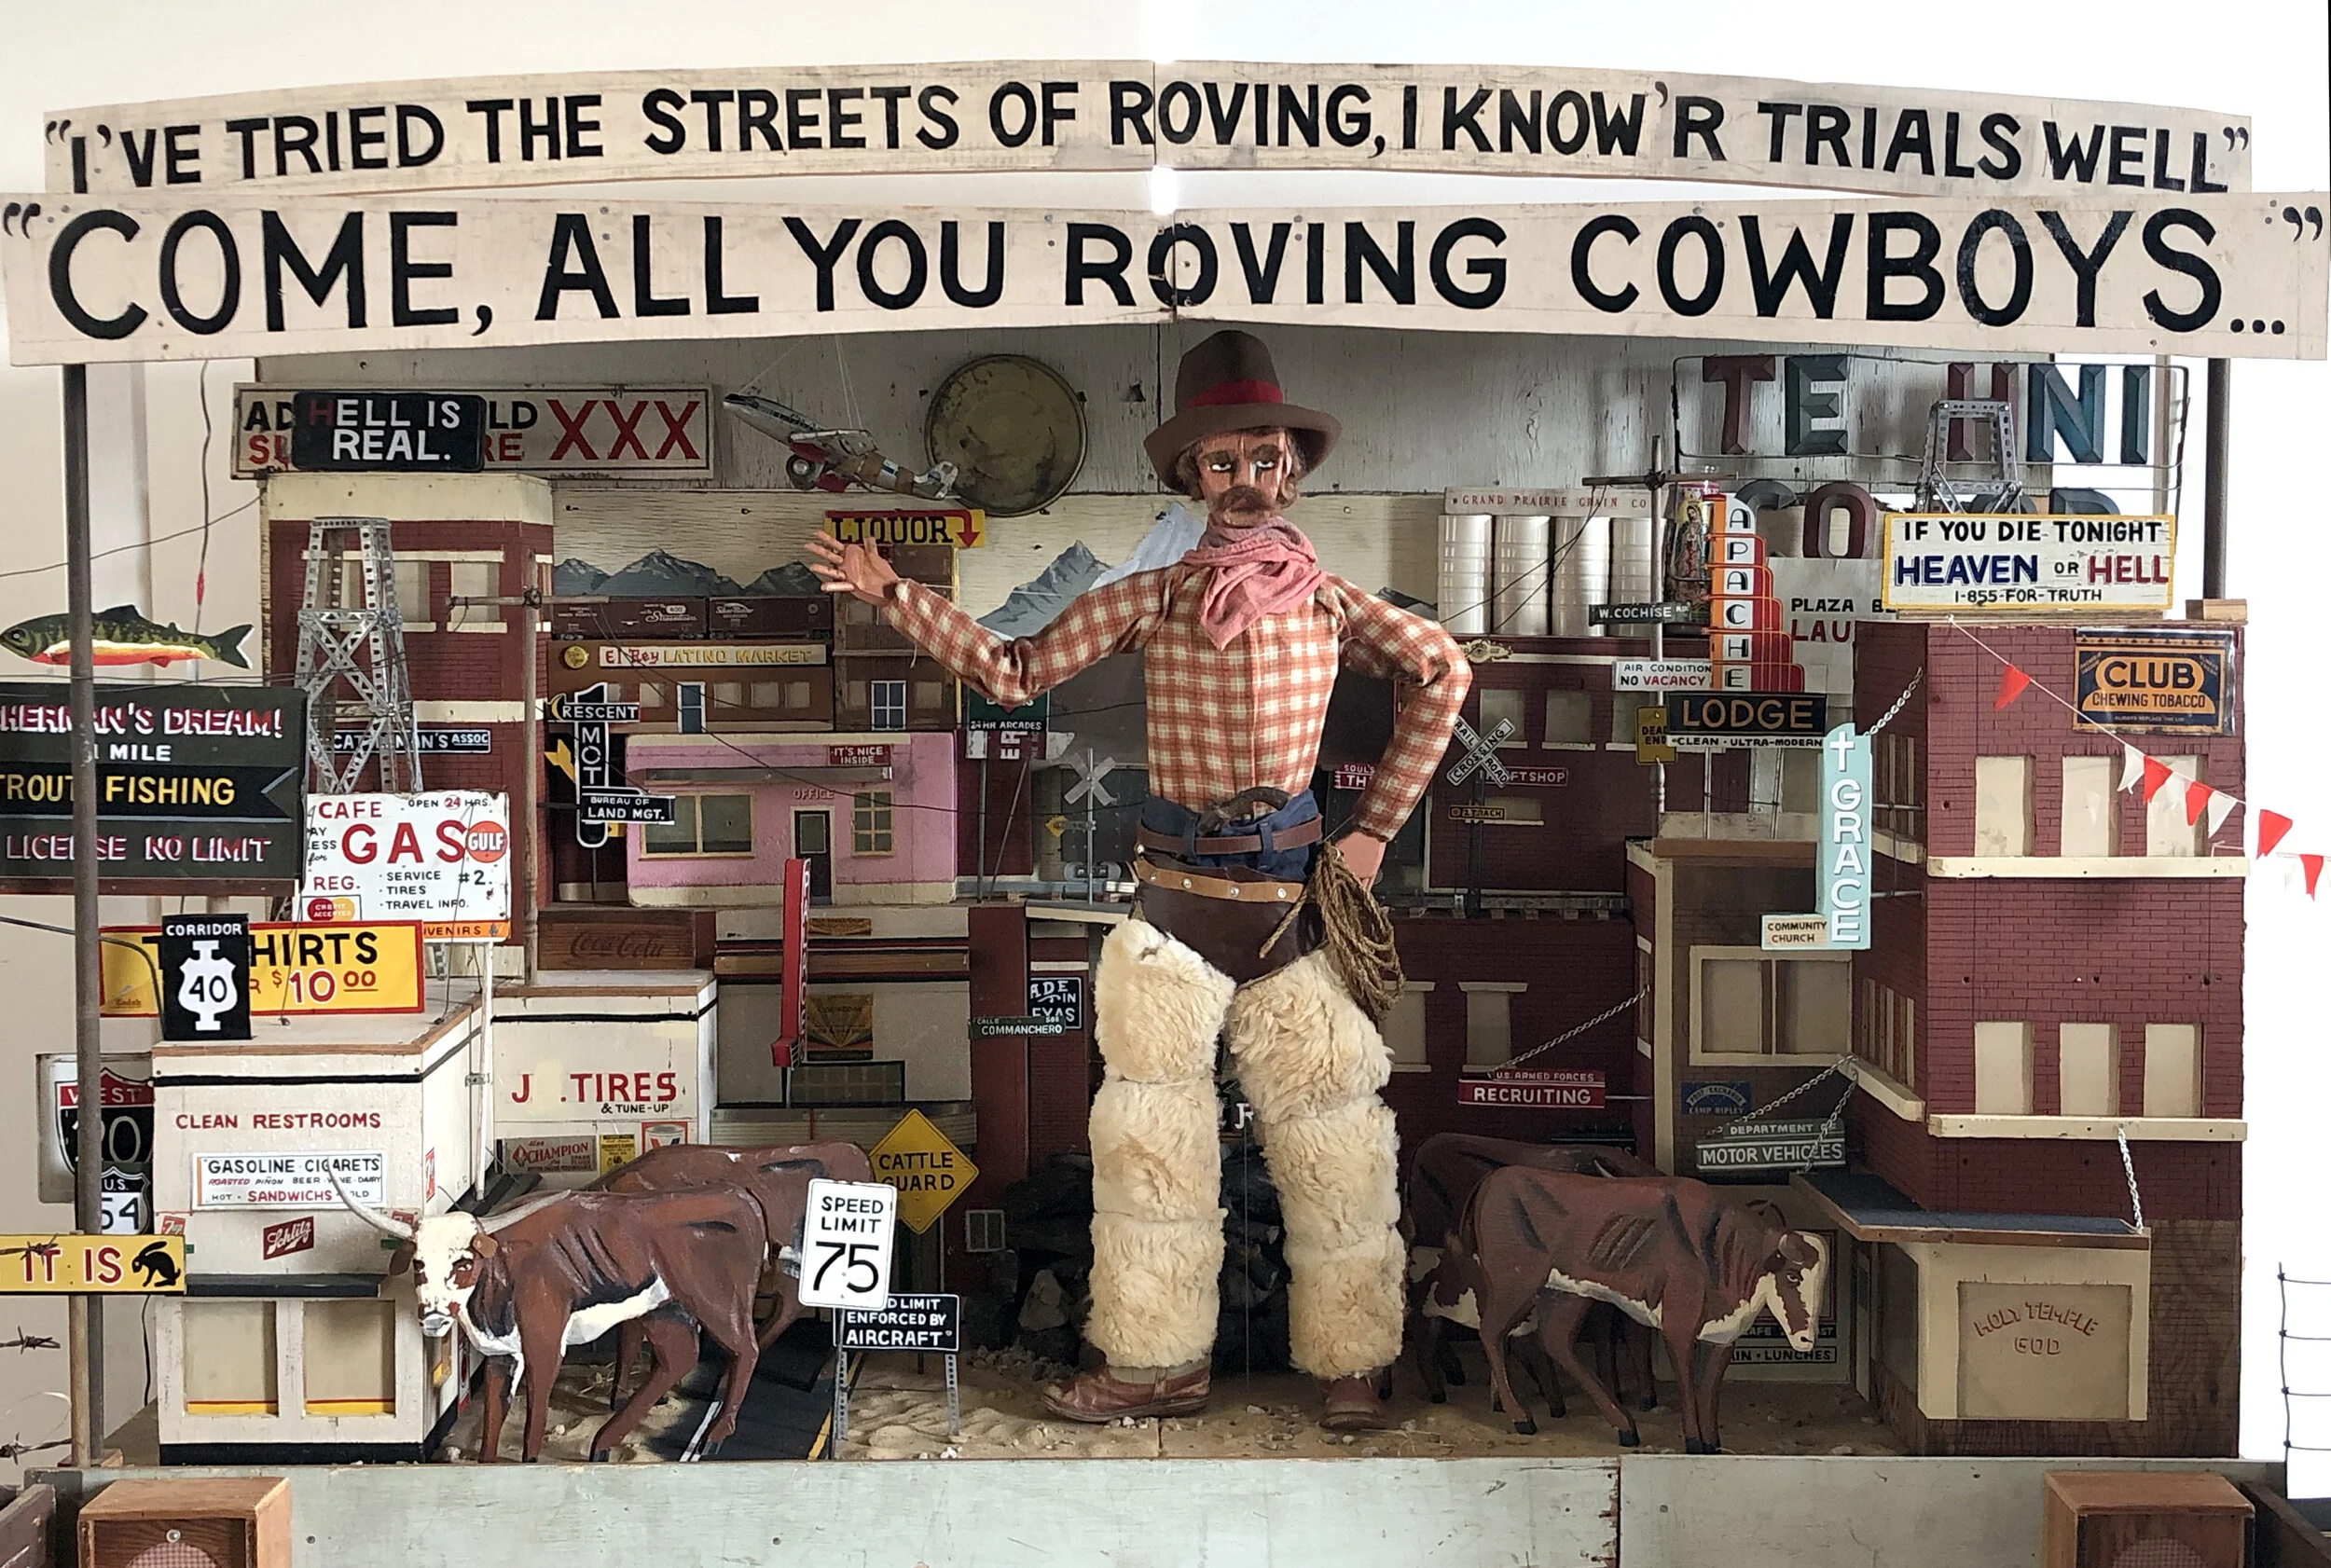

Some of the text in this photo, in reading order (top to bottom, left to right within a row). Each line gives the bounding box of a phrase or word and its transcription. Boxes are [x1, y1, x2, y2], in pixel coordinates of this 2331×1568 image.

[227, 104, 445, 180] TRIED
[467, 94, 603, 163] THE
[643, 85, 959, 156] STREETS
[990, 81, 1079, 147] OF
[1111, 80, 1385, 158] ROVING,
[1402, 85, 1415, 150] I
[1759, 102, 2021, 180] TRIALS
[536, 213, 760, 321] ALL
[782, 216, 1005, 311] YOU
[1066, 217, 1508, 309] ROVING
[309, 398, 461, 429] HELL IS
[546, 400, 700, 460] XXX
[333, 430, 451, 461] REAL.
[1463, 494, 1503, 504] GRAND
[1514, 495, 1566, 507] PRAIRIE
[1579, 496, 1617, 507] GRAIN
[832, 516, 953, 543] LIQUOR
[1905, 521, 2162, 543] IF YOU DIE TONIGHT
[1895, 555, 2170, 586] HEAVEN OR HELL
[1791, 598, 1854, 612] PLAZA
[606, 649, 812, 666] El Rey LATINO MARKET
[1621, 676, 1705, 686] NO VACANCY
[2104, 661, 2196, 689] CLUB
[2092, 693, 2205, 708] CHEWING TOBACCO
[1683, 699, 1813, 729] LODGE
[1000, 721, 1041, 730] ARCADES
[1454, 721, 1475, 746] RAIL
[452, 733, 488, 744] ASSOC
[1678, 737, 1823, 747] CLEAN ULTRA-MODERN
[110, 744, 172, 762] MILE
[834, 746, 883, 756] IT'S NICE
[841, 756, 875, 764] INSIDE
[1344, 764, 1375, 774] SOUL'S
[1485, 757, 1508, 783] ROAD
[1529, 772, 1565, 783] SHOP
[105, 776, 235, 805] FISHING
[793, 789, 834, 800] OFFICE
[407, 799, 439, 807] OPEN
[445, 798, 461, 807] 24
[590, 796, 630, 805] BUREAU
[318, 801, 382, 818] CAFE
[588, 807, 665, 820] LAND MGT.
[145, 836, 186, 860] NO
[192, 837, 271, 861] LIMIT
[341, 819, 466, 864] GAS
[468, 832, 503, 852] GULF
[1830, 778, 1864, 942] GRACE
[313, 876, 360, 890] REG.
[387, 871, 441, 881] SERVICE
[387, 886, 426, 895] TIRES
[386, 901, 434, 909] TRAVEL
[166, 923, 242, 936] CORRIDOR
[1768, 921, 1827, 931] COMMUNITY
[1772, 933, 1815, 943] CHURCH
[188, 975, 228, 1003] 40
[1030, 981, 1069, 999] ADE
[1063, 993, 1076, 1003] IN
[982, 1025, 1062, 1036] COMMANCHERO
[1553, 1073, 1594, 1082] FORCES
[1474, 1087, 1591, 1104] RECRUITING
[600, 1103, 669, 1114] & TUNE-UP
[176, 1113, 381, 1129] CLEAN RESTROOMS
[1730, 1123, 1814, 1135] DEPARTMENT
[527, 1142, 588, 1163] CHAMPION
[879, 1151, 953, 1170] CATTLE
[1703, 1144, 1842, 1164] MOTOR VEHICLES
[208, 1158, 380, 1174] GASOLINE CIGARETS
[104, 1177, 129, 1191] U.S.
[882, 1174, 955, 1191] GUARD
[248, 1190, 333, 1202] SANDWICHS
[821, 1196, 884, 1214] SPEED
[821, 1216, 881, 1233] LIMIT
[267, 1220, 310, 1256] Schlitz
[23, 1247, 123, 1284] IT IS
[813, 1241, 879, 1294] 75
[901, 1298, 941, 1310] LIMIT
[847, 1312, 946, 1326] ENFORCED BY
[846, 1329, 944, 1346] AIRCRAFT
[1764, 1350, 1831, 1361] LUNCHES
